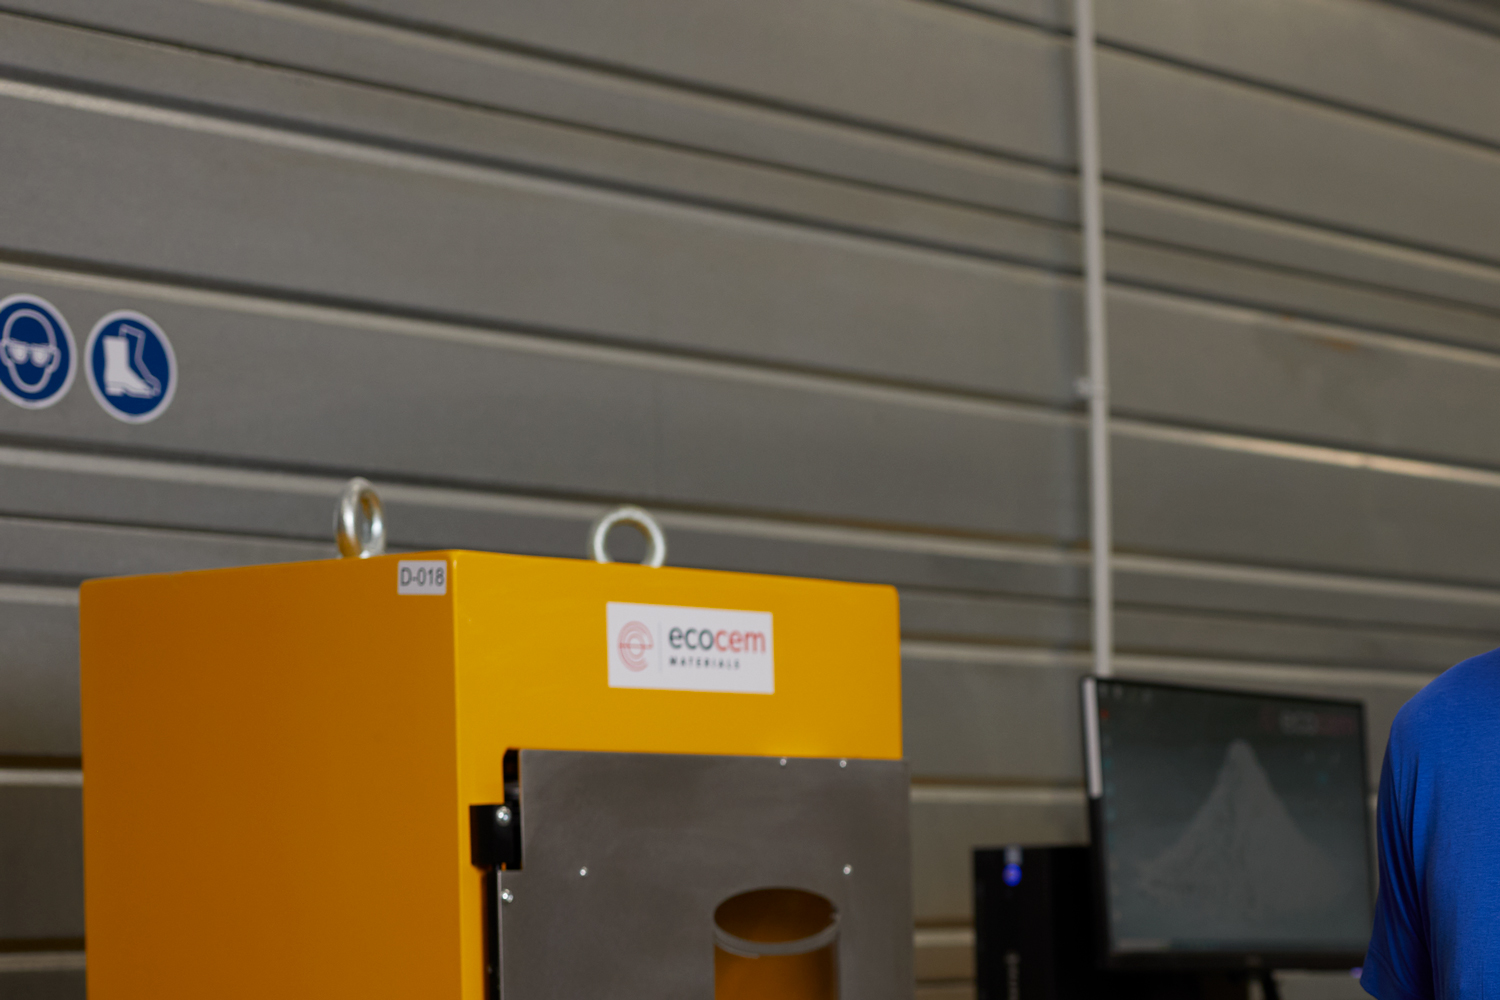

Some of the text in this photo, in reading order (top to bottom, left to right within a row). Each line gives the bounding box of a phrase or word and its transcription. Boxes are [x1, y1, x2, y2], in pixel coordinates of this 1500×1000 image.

[400, 566, 445, 587] D-018
[668, 626, 767, 654] ecocem
[669, 656, 740, 670] MATERIALS
